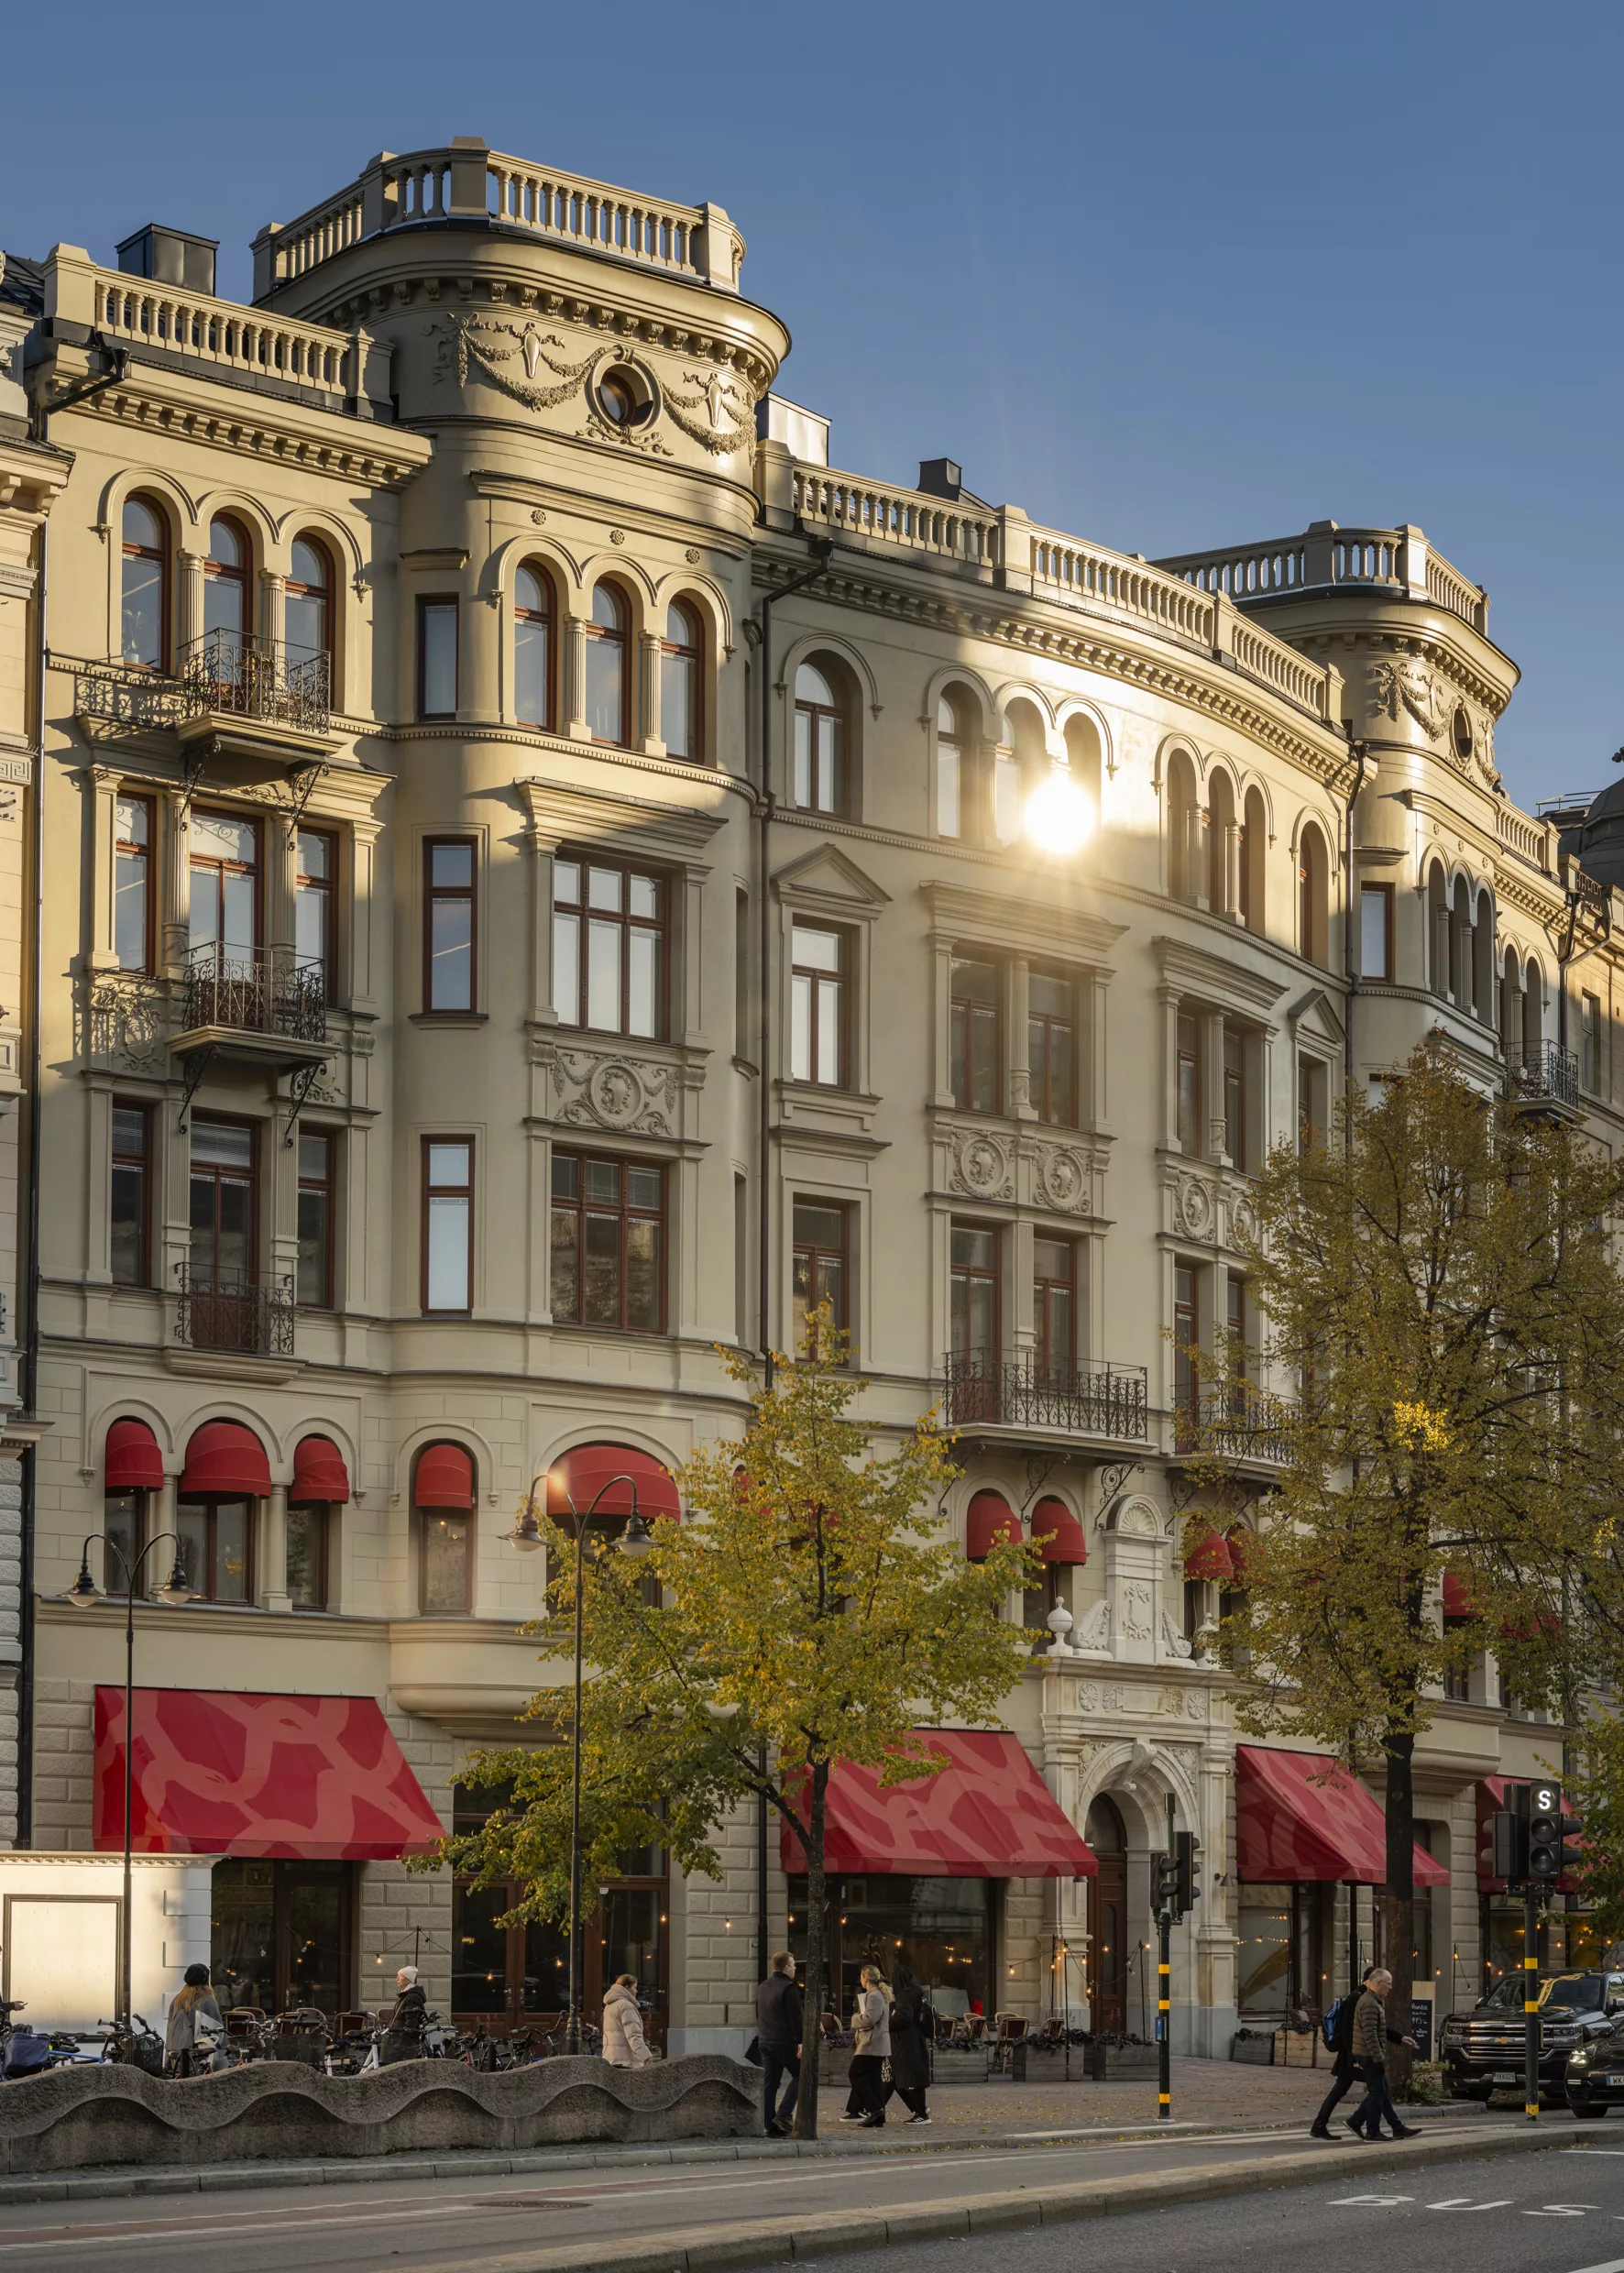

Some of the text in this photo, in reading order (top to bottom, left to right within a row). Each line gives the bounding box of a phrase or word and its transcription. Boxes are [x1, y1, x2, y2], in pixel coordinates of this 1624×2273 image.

[1539, 1790, 1551, 1810] S
[1612, 2076, 1624, 2085] WK
[1326, 2194, 1624, 2220] BUS
